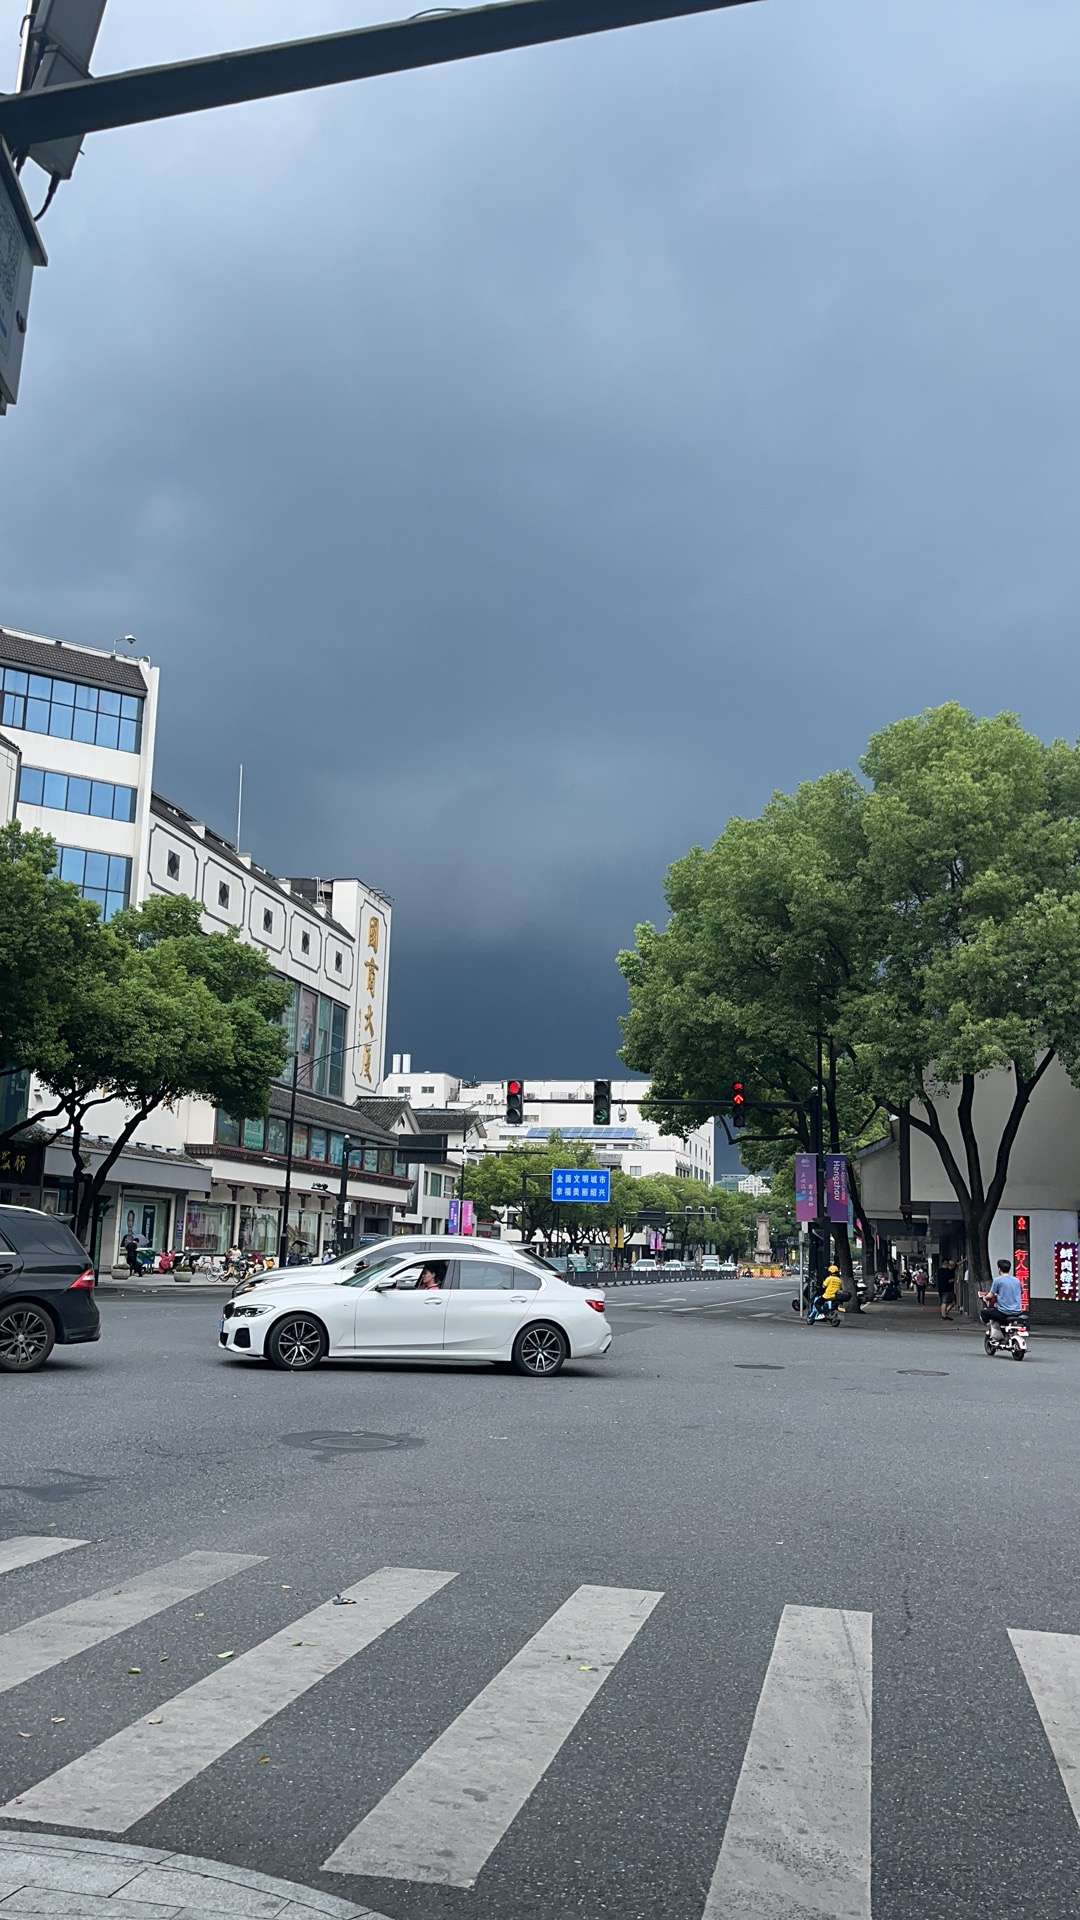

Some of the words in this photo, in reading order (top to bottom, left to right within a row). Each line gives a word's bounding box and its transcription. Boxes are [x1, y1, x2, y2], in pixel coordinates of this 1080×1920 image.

[556, 1174, 607, 1184] 全国文明城市
[556, 1187, 606, 1197] 幸福美丽绍兴
[1060, 1248, 1074, 1294] 鲜肉粽子
